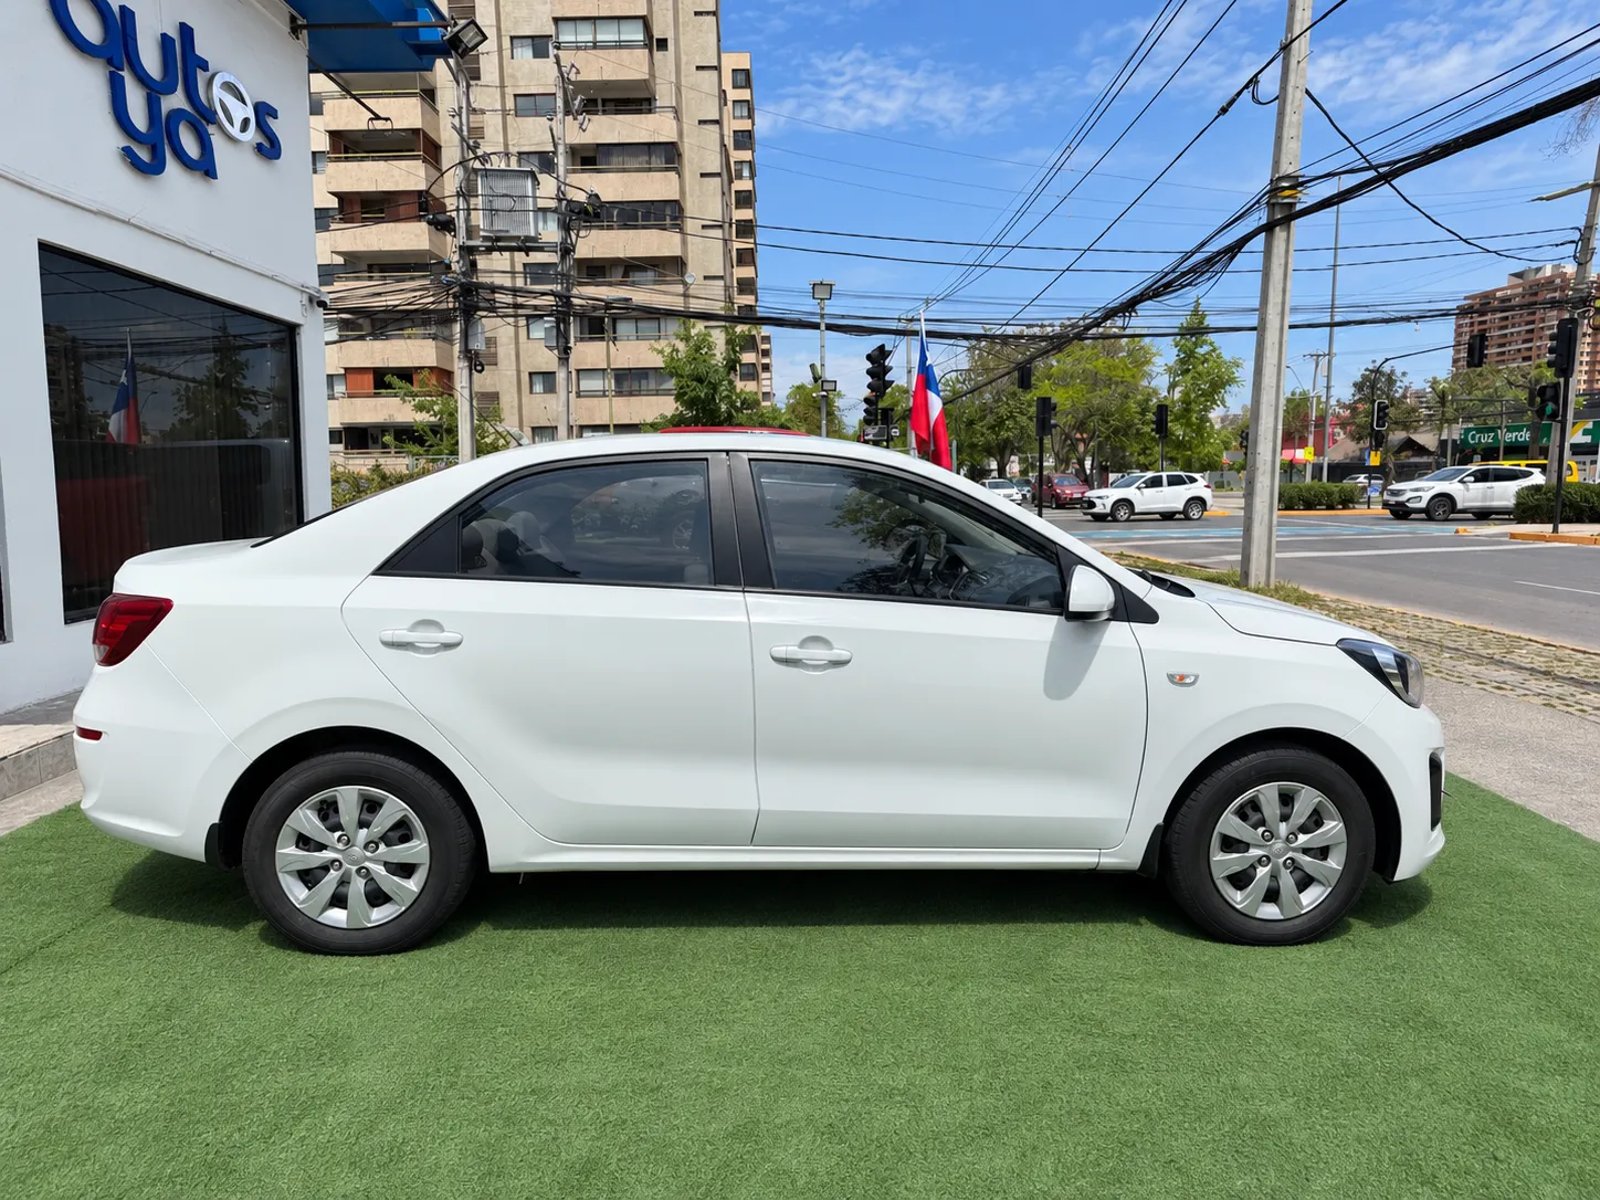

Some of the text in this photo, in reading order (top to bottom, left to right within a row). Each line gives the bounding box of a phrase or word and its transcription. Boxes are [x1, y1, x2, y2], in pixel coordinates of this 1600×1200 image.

[109, 70, 218, 180] ya
[1468, 427, 1531, 444] Cruz Verde
